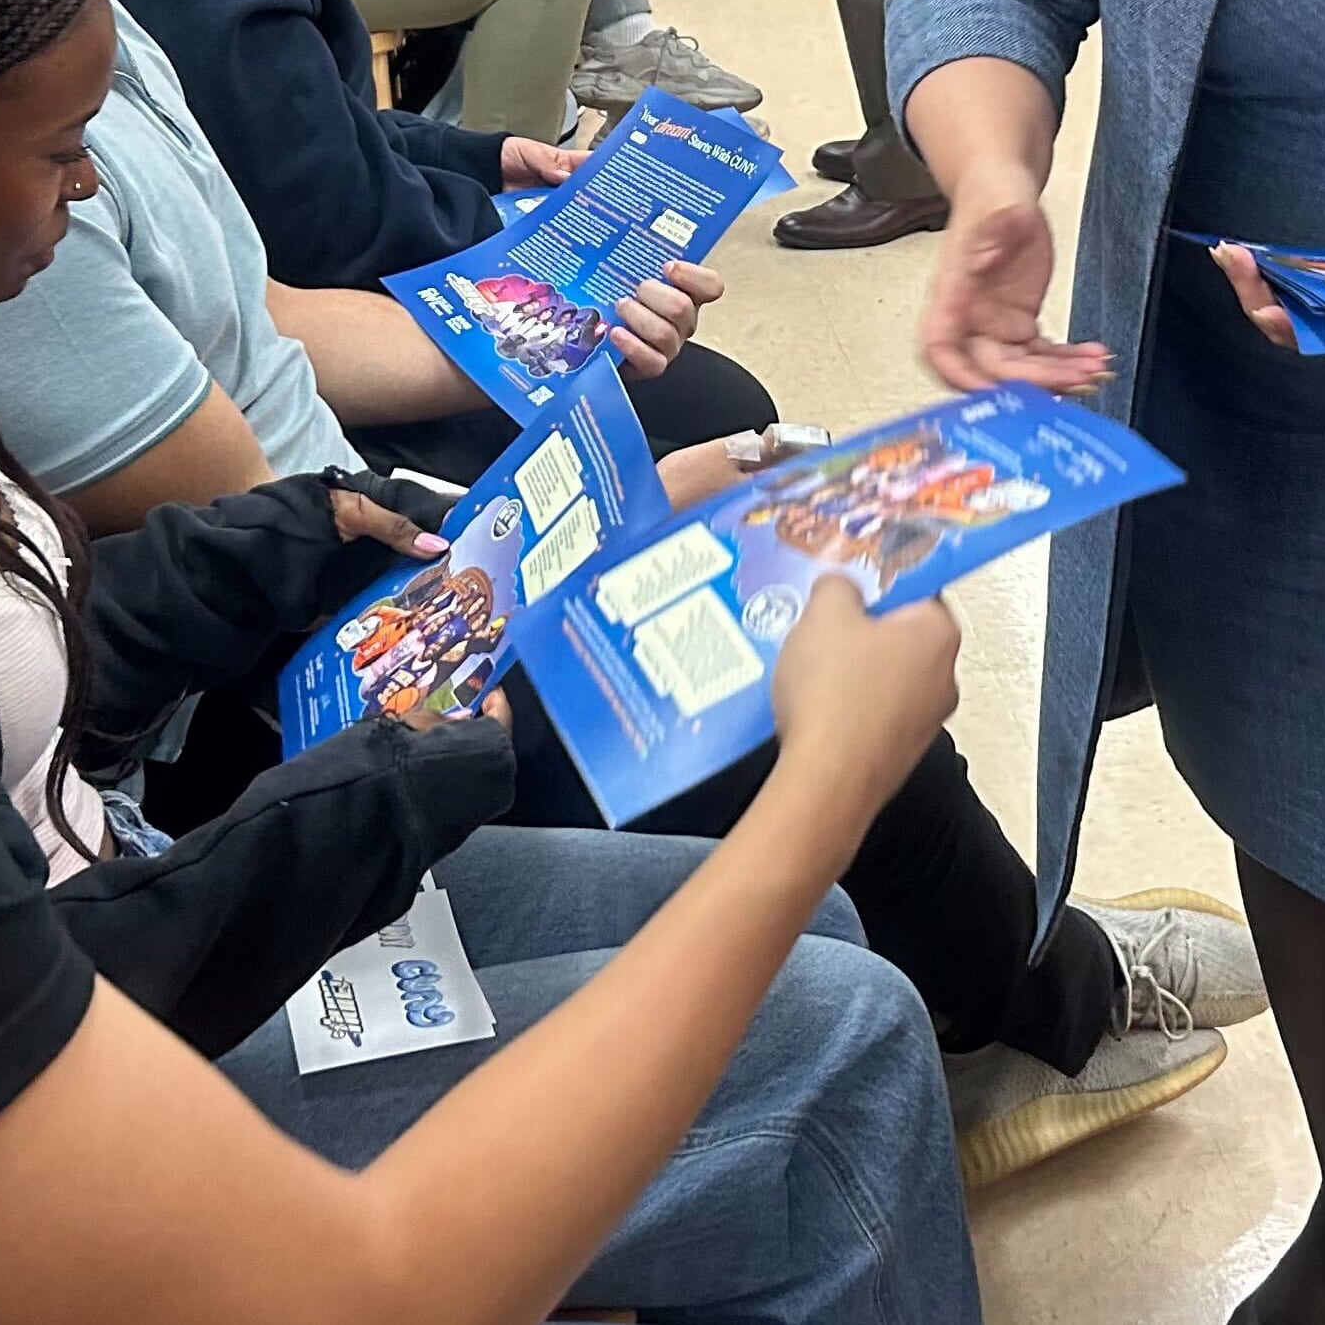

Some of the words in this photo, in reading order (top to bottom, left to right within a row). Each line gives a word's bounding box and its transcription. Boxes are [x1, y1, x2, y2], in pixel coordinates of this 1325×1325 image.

[640, 107, 659, 126] Your
[687, 133, 713, 156] Starts
[711, 144, 731, 164] With
[729, 154, 758, 176] CUNY
[391, 959, 456, 1028] CUNY
